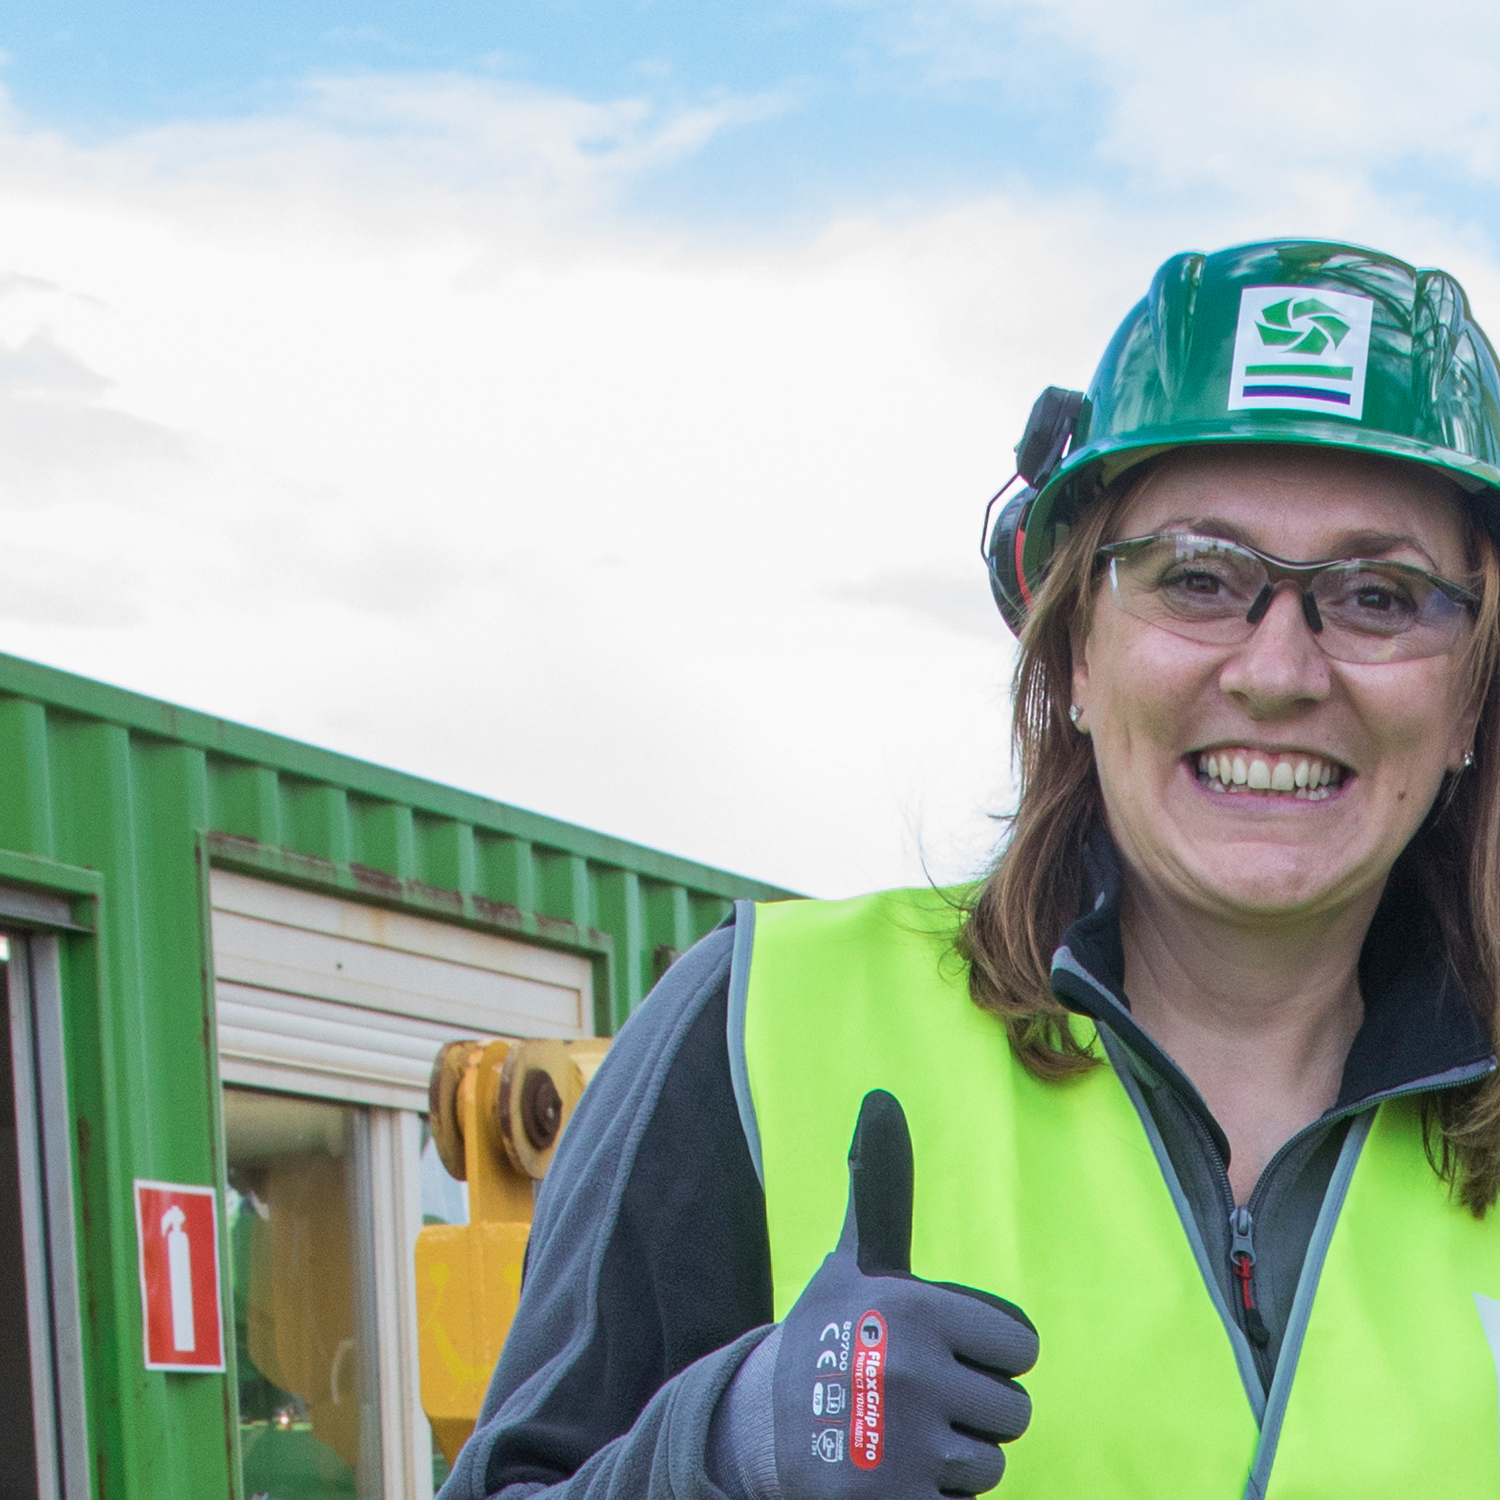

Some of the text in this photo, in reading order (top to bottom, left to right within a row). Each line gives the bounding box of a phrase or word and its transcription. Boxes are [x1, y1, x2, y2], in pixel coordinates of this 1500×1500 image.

[816, 1323, 840, 1368] CE
[854, 1352, 866, 1448] PROTECT YOUR HANDS
[864, 1351, 881, 1460] FlexGrip Pro
